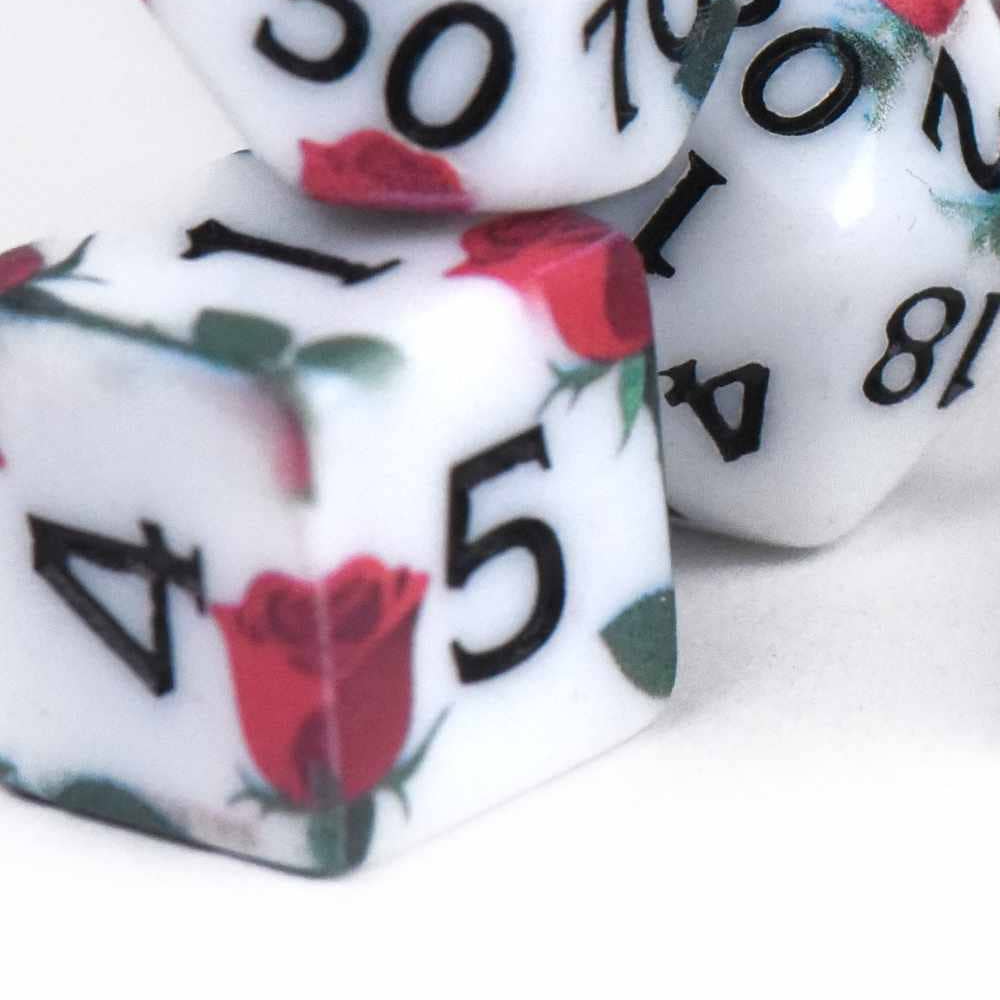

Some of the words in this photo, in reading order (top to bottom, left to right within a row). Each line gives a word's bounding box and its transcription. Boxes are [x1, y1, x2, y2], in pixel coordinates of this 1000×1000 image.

[180, 217, 403, 286] 1
[656, 359, 770, 463] 4
[27, 512, 208, 698] 4
[445, 424, 567, 685] 5
